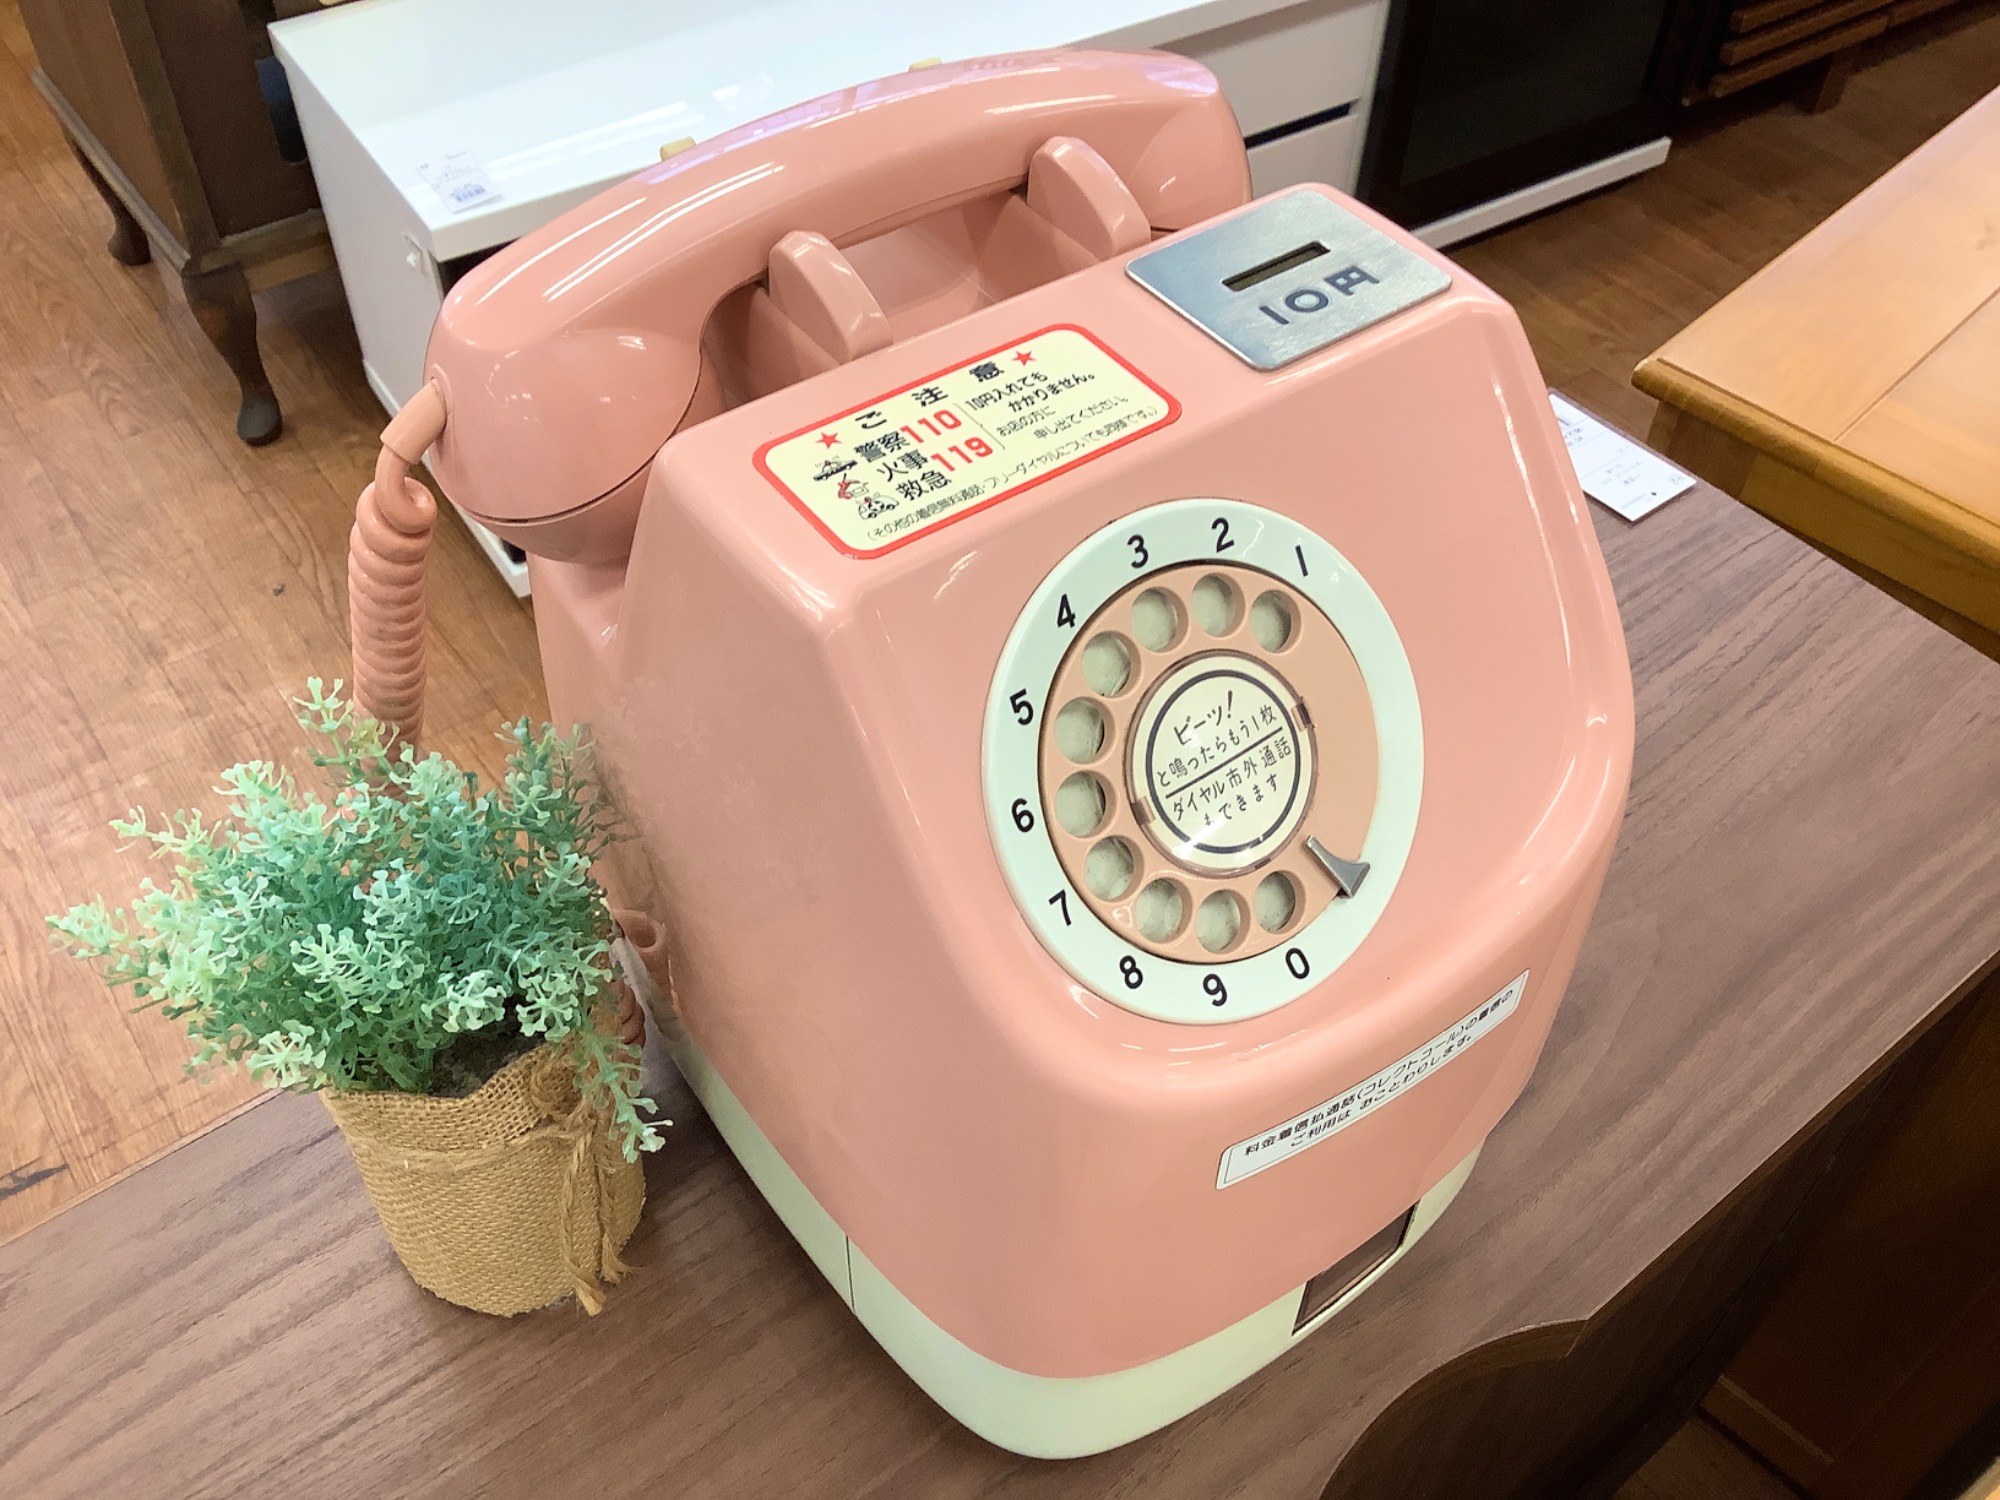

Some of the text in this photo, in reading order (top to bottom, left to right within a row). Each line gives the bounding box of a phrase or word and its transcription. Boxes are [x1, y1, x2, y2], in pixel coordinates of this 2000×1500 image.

[1259, 265, 1380, 325] 10円
[965, 371, 1048, 411] 10円入れても
[1008, 373, 1095, 413] かかりません。
[997, 405, 1056, 436] お店の方に
[877, 449, 928, 482] 火事
[931, 437, 993, 471] 119
[896, 470, 952, 501] 救急
[1127, 534, 1149, 569] 3
[1211, 517, 1235, 553] 2
[1295, 545, 1309, 577] 1
[1056, 593, 1076, 628] 4
[1009, 688, 1034, 726] 5
[1157, 704, 1277, 788] と鳴ったらもう1枚
[1173, 737, 1292, 821] ダイヤル市外通話
[1011, 798, 1035, 833] 6
[1048, 889, 1072, 926] 7
[1119, 955, 1144, 990] 8
[1285, 947, 1310, 980] 0
[1202, 973, 1228, 1007] 9
